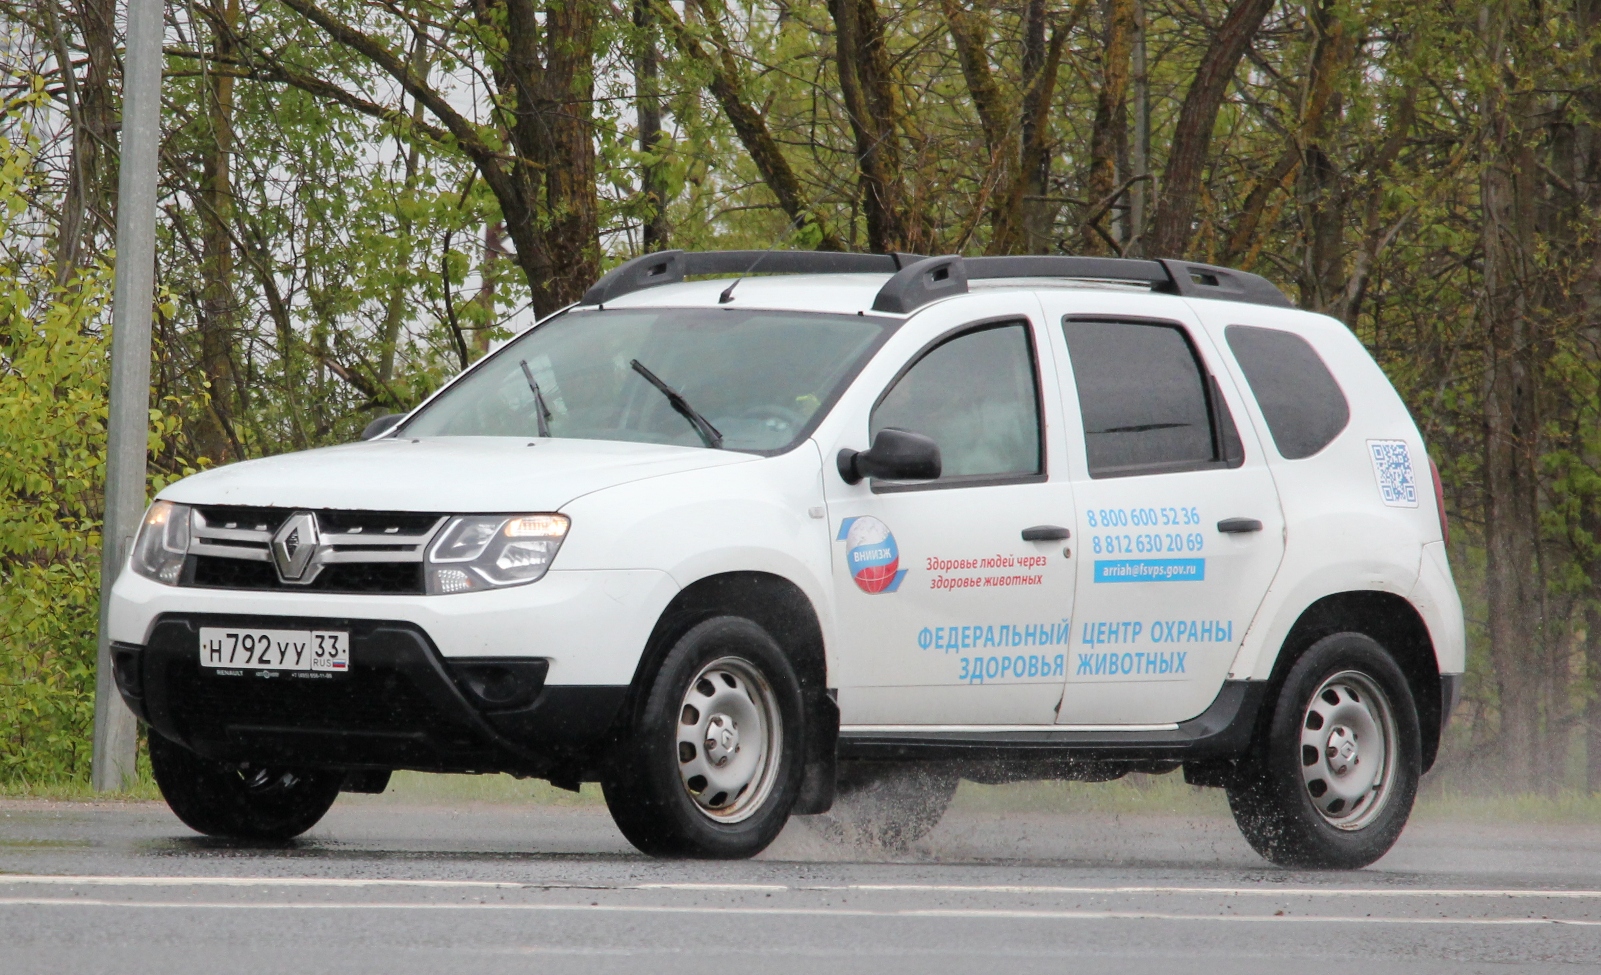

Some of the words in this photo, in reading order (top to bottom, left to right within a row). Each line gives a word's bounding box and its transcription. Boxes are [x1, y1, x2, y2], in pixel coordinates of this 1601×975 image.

[1087, 510, 1097, 527] 8
[1100, 509, 1127, 527] 800
[1131, 508, 1158, 526] 600
[1160, 507, 1179, 525] 52
[1181, 507, 1200, 525] 36
[1092, 536, 1102, 554] 8
[1105, 535, 1132, 553] 812
[1136, 534, 1162, 552] 630
[1166, 533, 1183, 552] 20
[1186, 533, 1203, 551] 69
[854, 548, 892, 562] ВНИИЗЖ
[926, 556, 978, 573] Здоровье
[980, 554, 1015, 568] людей
[1017, 556, 1047, 570] через
[1103, 563, 1196, 578] arriah@fsvps.gov.ru
[930, 575, 981, 591] здоровье
[983, 575, 1043, 587] животных
[917, 618, 1069, 653] ФЕДЕРАЛЬНЫЙ
[1082, 621, 1143, 648] ЦЕНТР
[1151, 620, 1233, 643] ОХРАНЫ
[315, 635, 339, 658] 33
[313, 658, 332, 667] RUS
[959, 654, 1064, 684] ЗДОРОВЬЯ
[1076, 652, 1187, 676] ЖИВОТНЫХ
